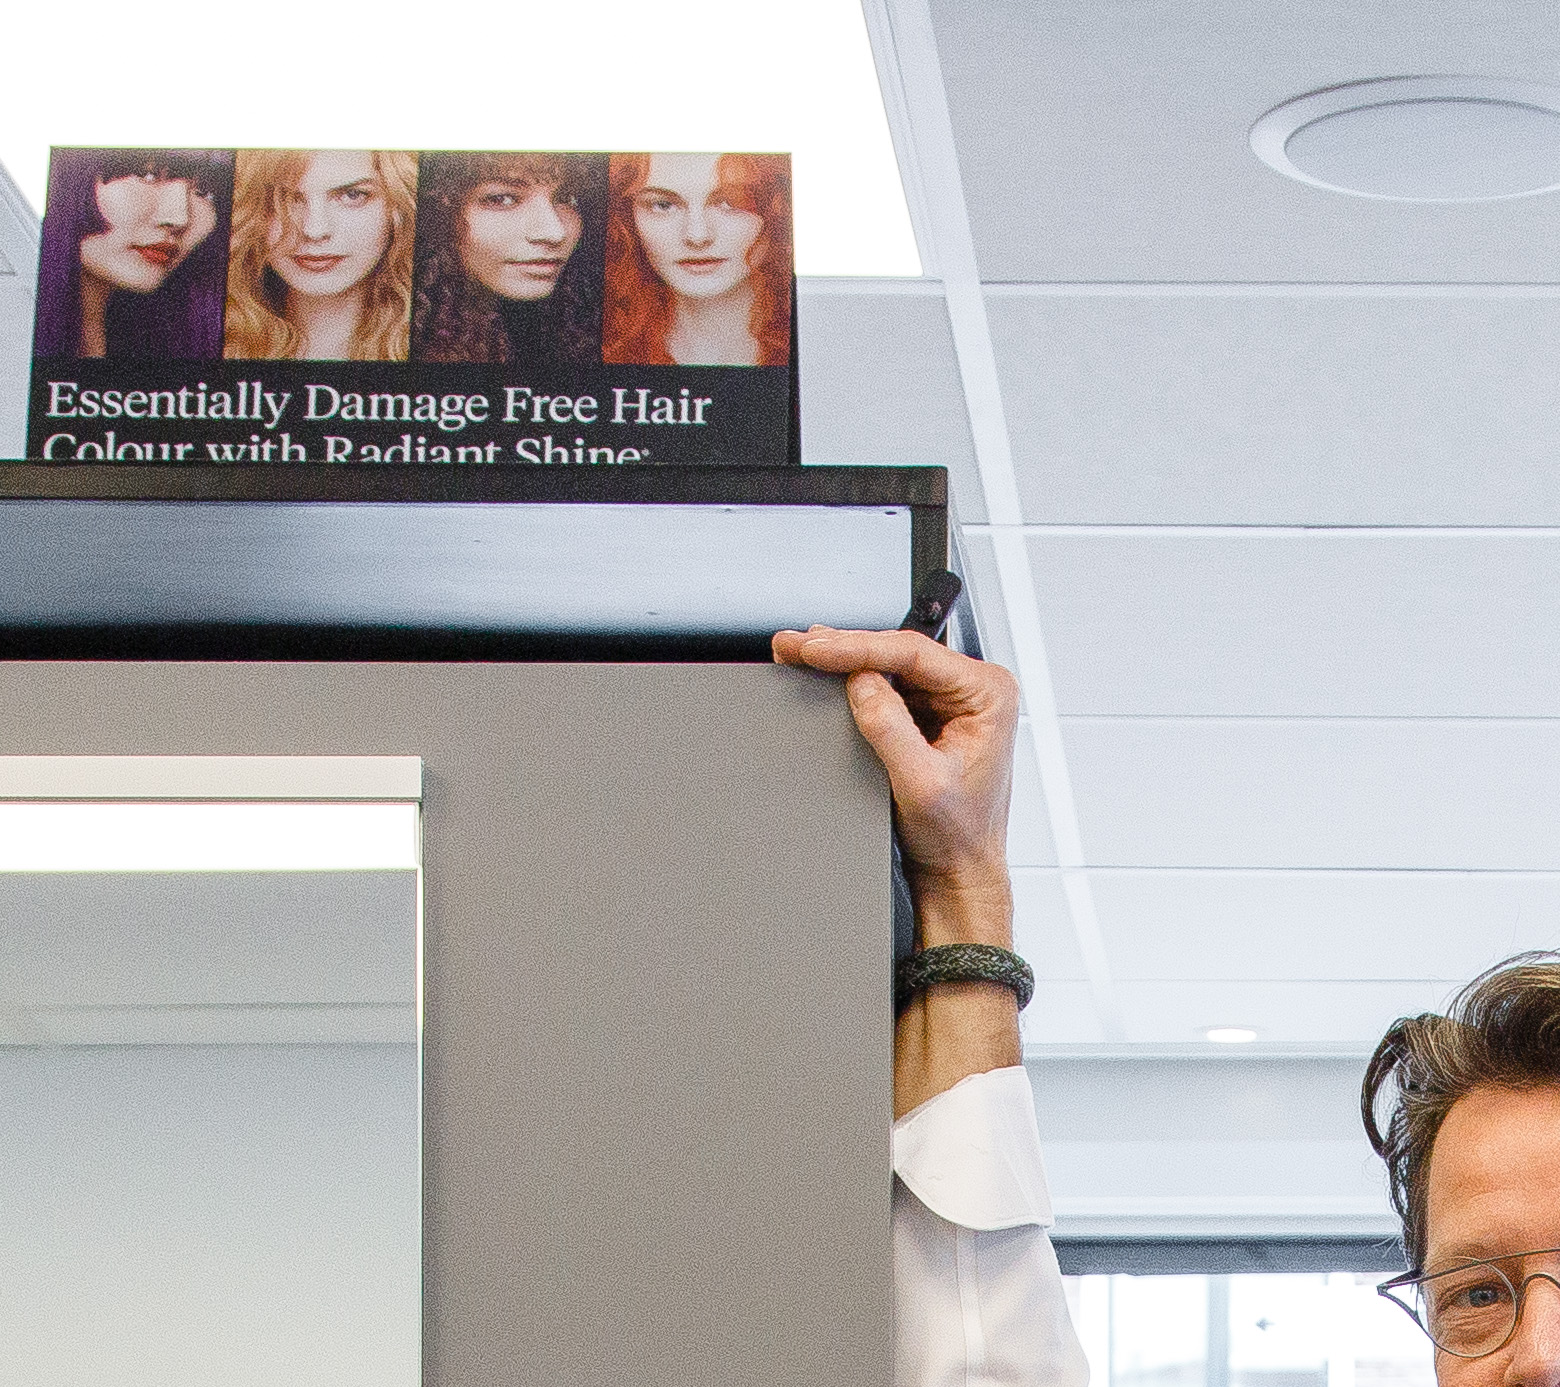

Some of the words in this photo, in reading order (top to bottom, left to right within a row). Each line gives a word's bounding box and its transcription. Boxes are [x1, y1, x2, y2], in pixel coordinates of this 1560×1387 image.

[45, 381, 288, 434] Essentially
[303, 384, 490, 431] Damage
[504, 386, 599, 424] Free
[612, 387, 713, 426] Hair
